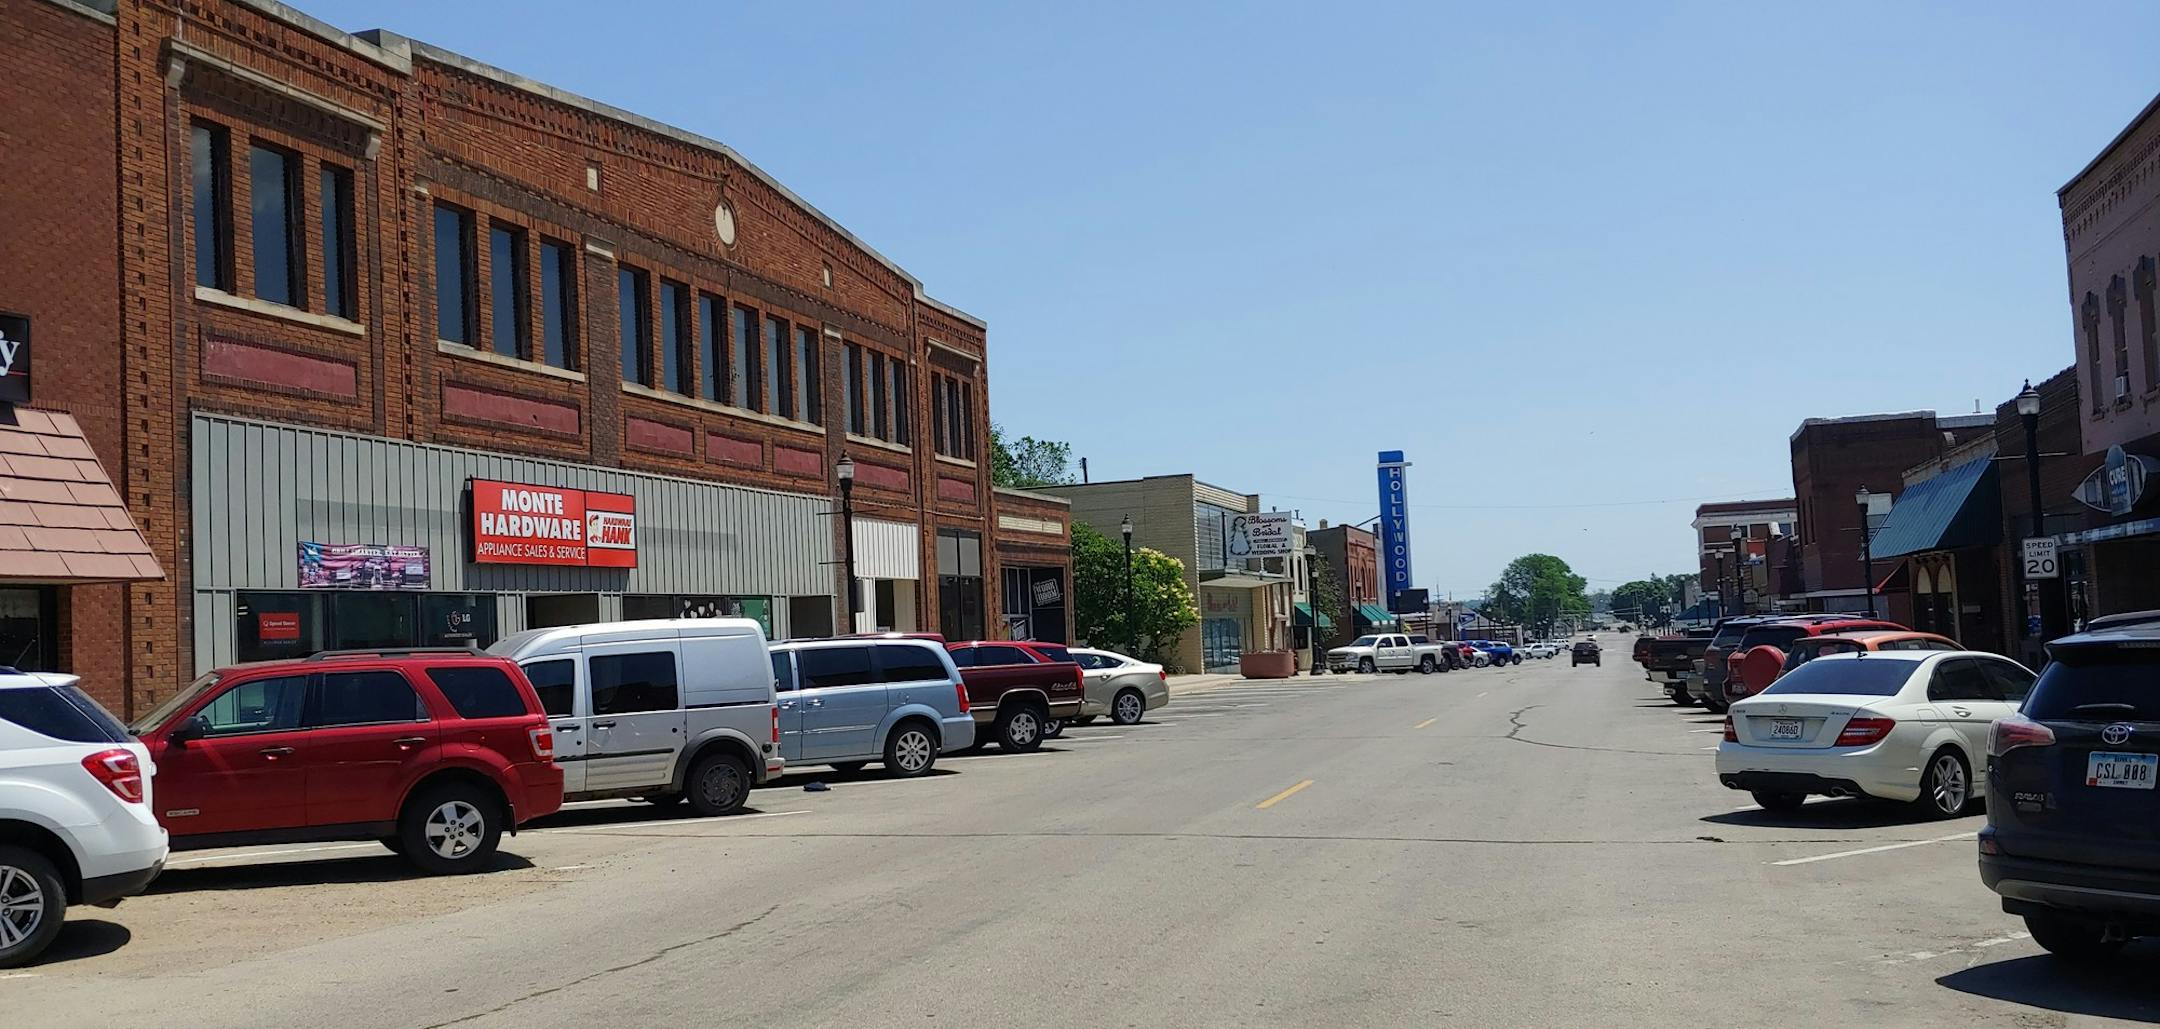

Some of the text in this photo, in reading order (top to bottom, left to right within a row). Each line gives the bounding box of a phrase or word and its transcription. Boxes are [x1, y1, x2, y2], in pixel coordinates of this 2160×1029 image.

[0, 330, 20, 376] y
[501, 488, 563, 515] MONTE
[480, 512, 581, 541] HARDWARE
[1248, 515, 1287, 525] Blossoms
[1389, 467, 1406, 582] HOLLYWOOD
[601, 525, 632, 544] HANK
[1252, 527, 1281, 537] Bridal
[477, 542, 586, 560] APPLIANCE SALES & SERVICE
[2025, 541, 2053, 549] SPEED
[2026, 559, 2054, 574] 20
[2096, 762, 2147, 781] CSL 008
